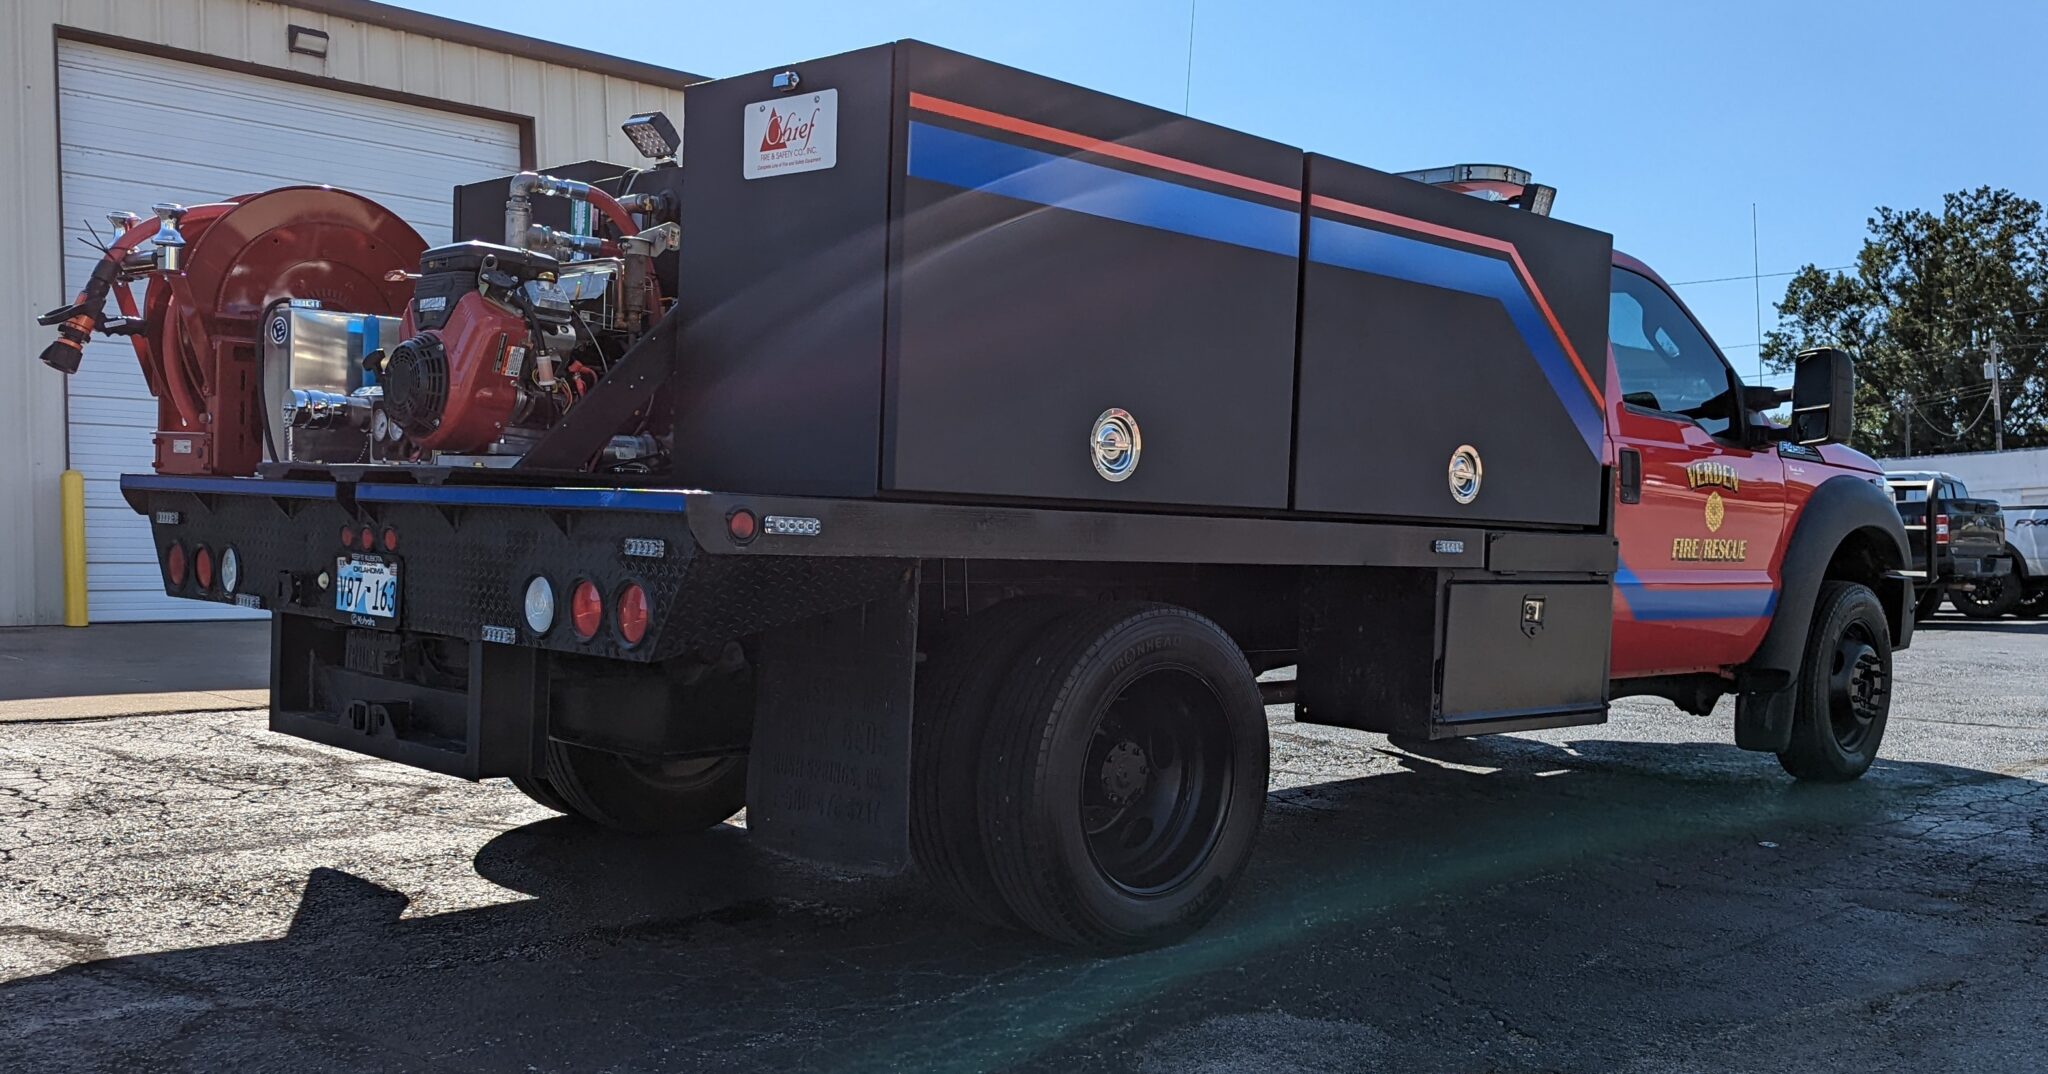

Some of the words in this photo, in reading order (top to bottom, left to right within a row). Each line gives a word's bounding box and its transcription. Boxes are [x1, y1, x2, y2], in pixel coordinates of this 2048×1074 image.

[766, 108, 820, 150] Chief
[760, 153, 770, 161] FIRE
[776, 150, 793, 160] SAFETY
[1686, 462, 1739, 493] VERDEN
[353, 566, 384, 574] OKLAHOMA
